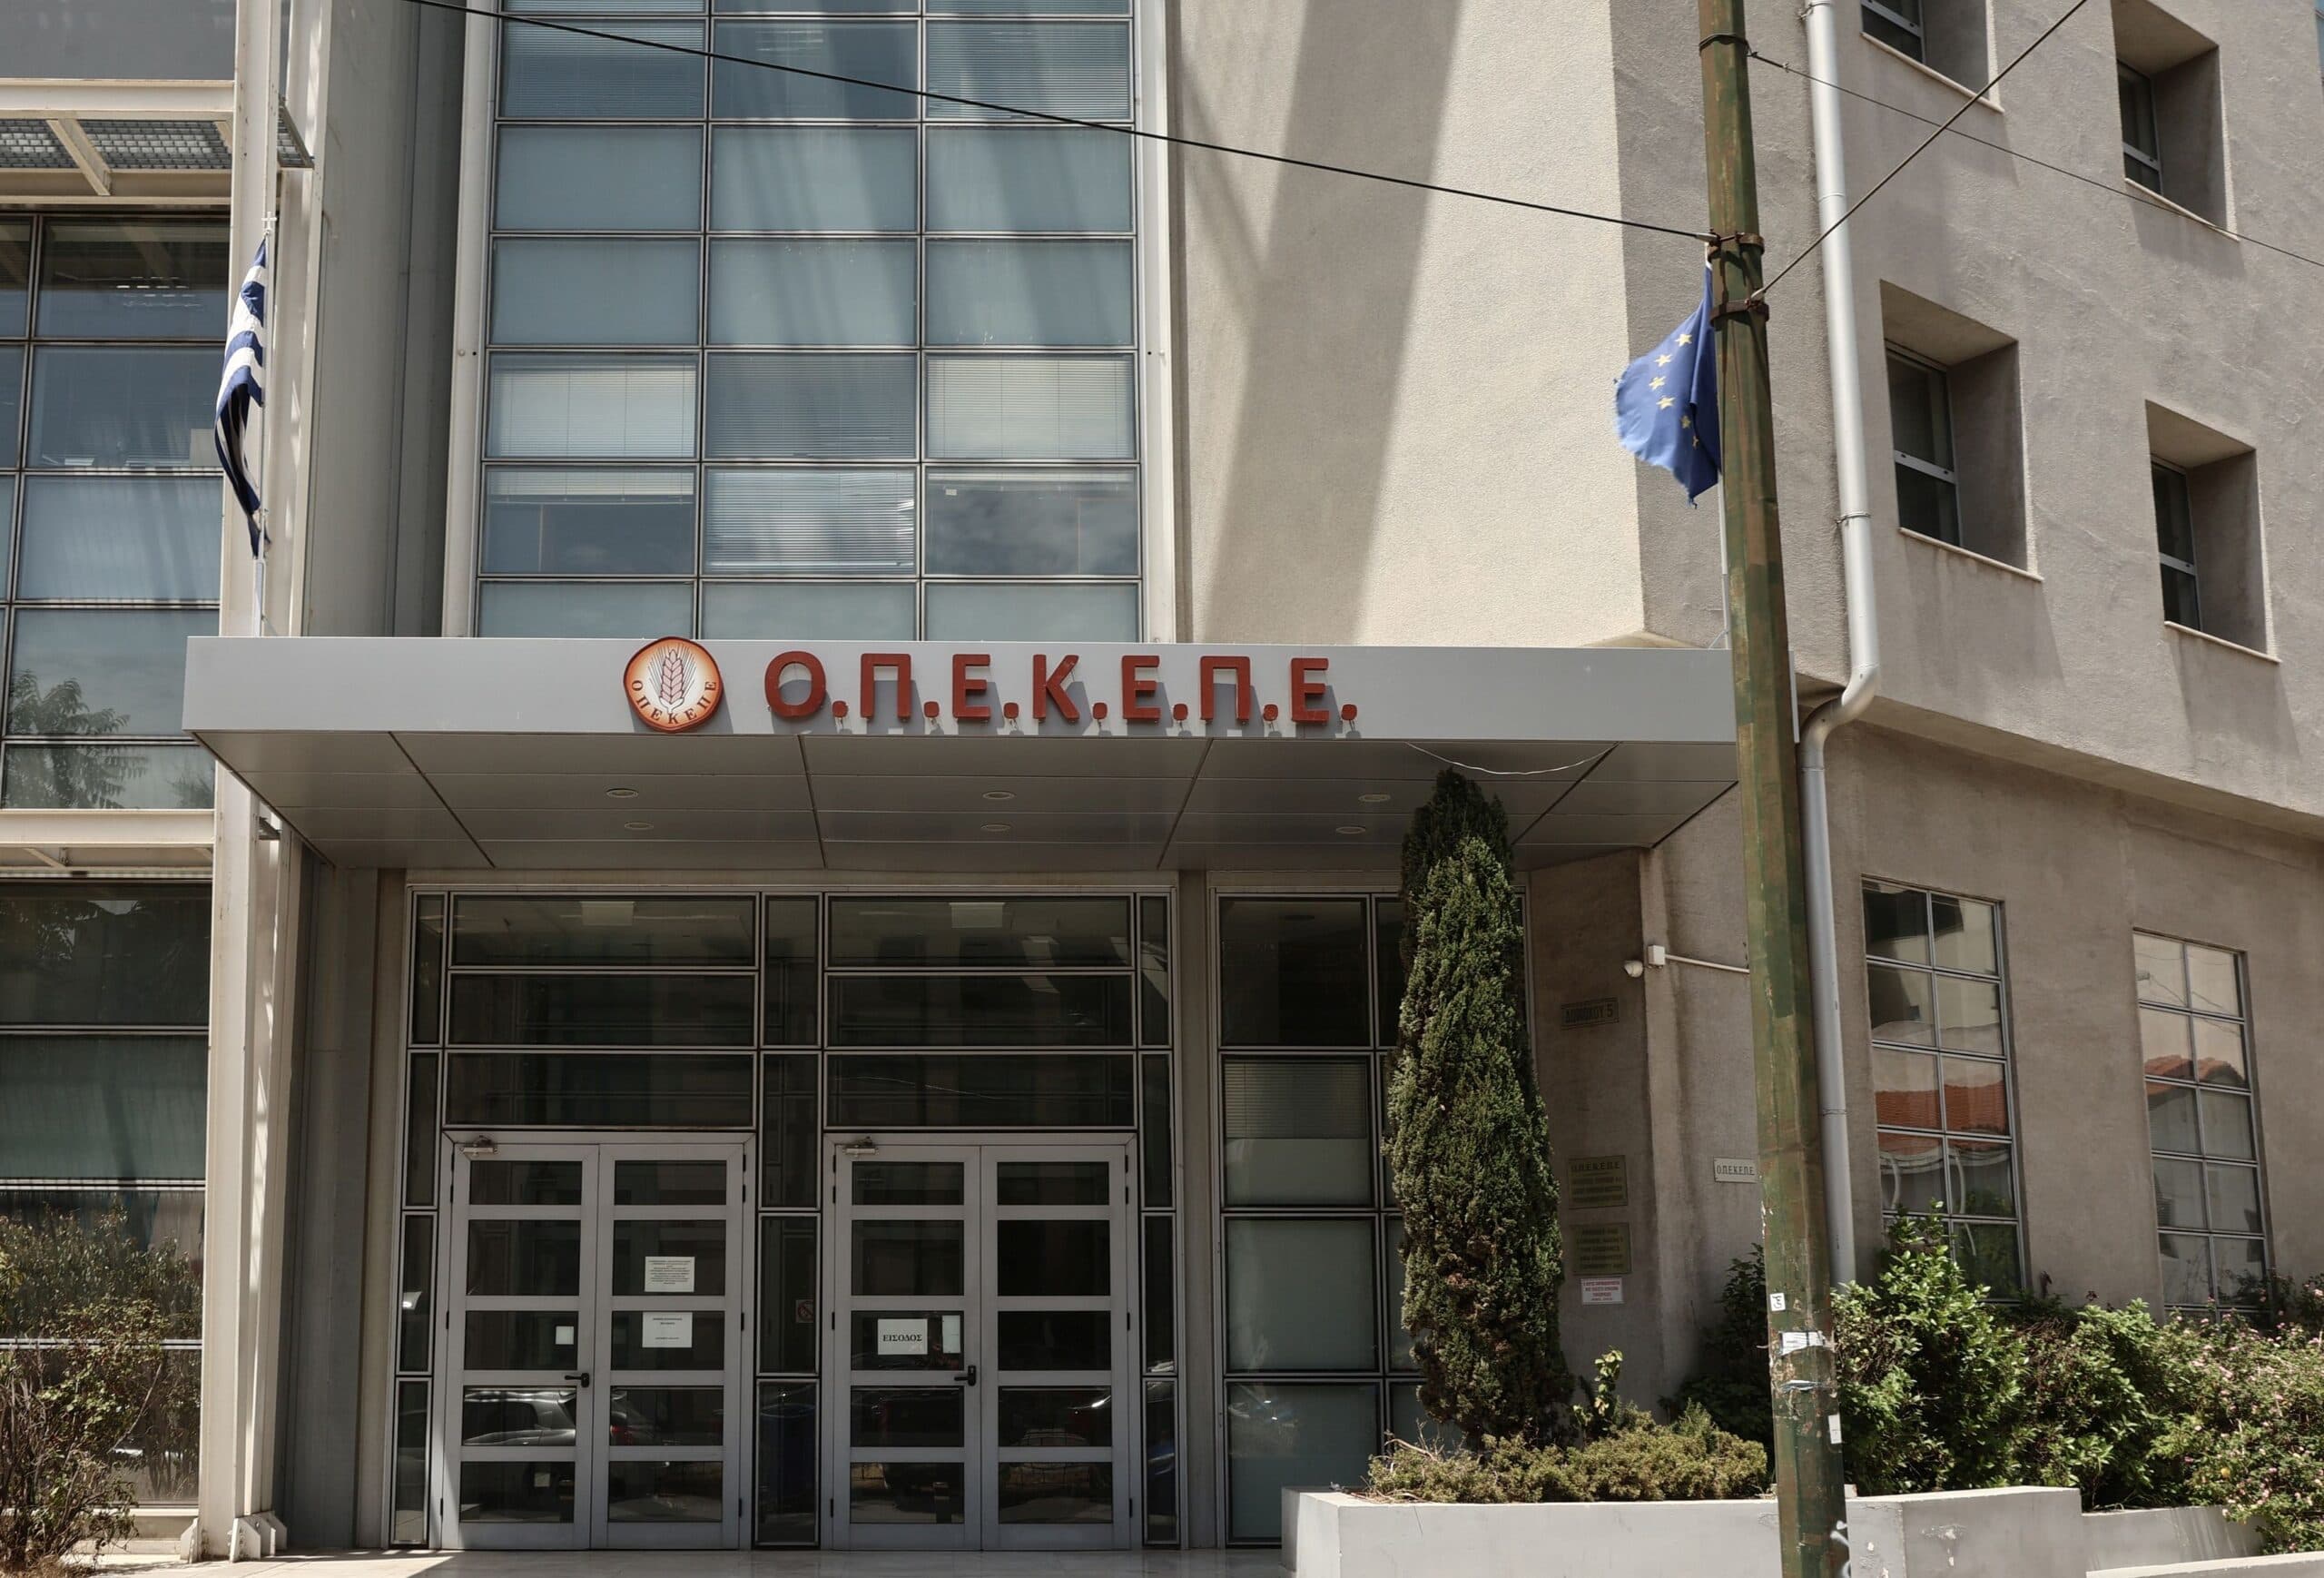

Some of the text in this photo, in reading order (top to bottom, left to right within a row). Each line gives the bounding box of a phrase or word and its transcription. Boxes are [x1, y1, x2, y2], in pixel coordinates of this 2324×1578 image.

[632, 680, 717, 725] ΟΠΕΚΕΠΕ
[764, 650, 1358, 724] Ο.Π.Ε.Κ.Ε.Π.Ε.
[882, 1334, 922, 1342] ΕΙΣΟΔΟΣ
